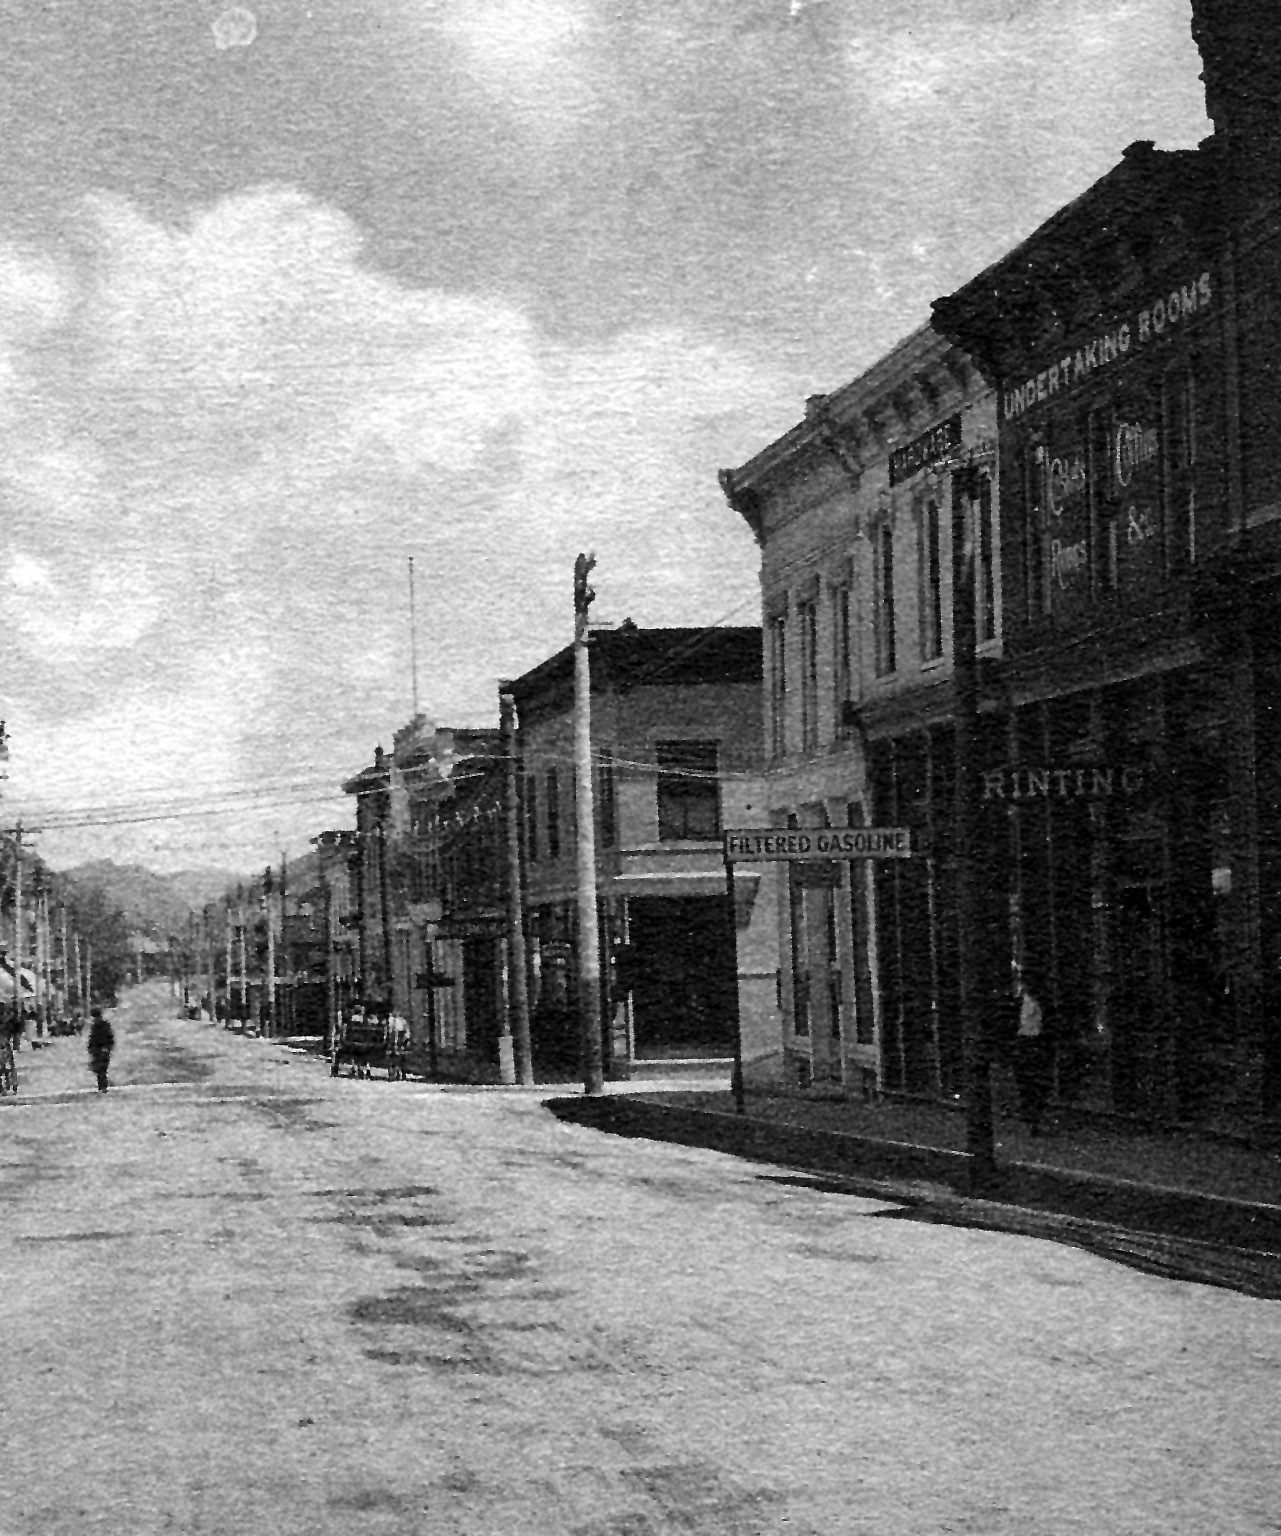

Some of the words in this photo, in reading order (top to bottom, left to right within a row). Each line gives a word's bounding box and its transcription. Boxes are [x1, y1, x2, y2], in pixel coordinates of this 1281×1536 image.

[1004, 324, 1130, 420] UNDERTAKING
[1138, 273, 1211, 342] ROOMS
[729, 835, 810, 854] FILTERED
[817, 832, 905, 852] GASOLINE
